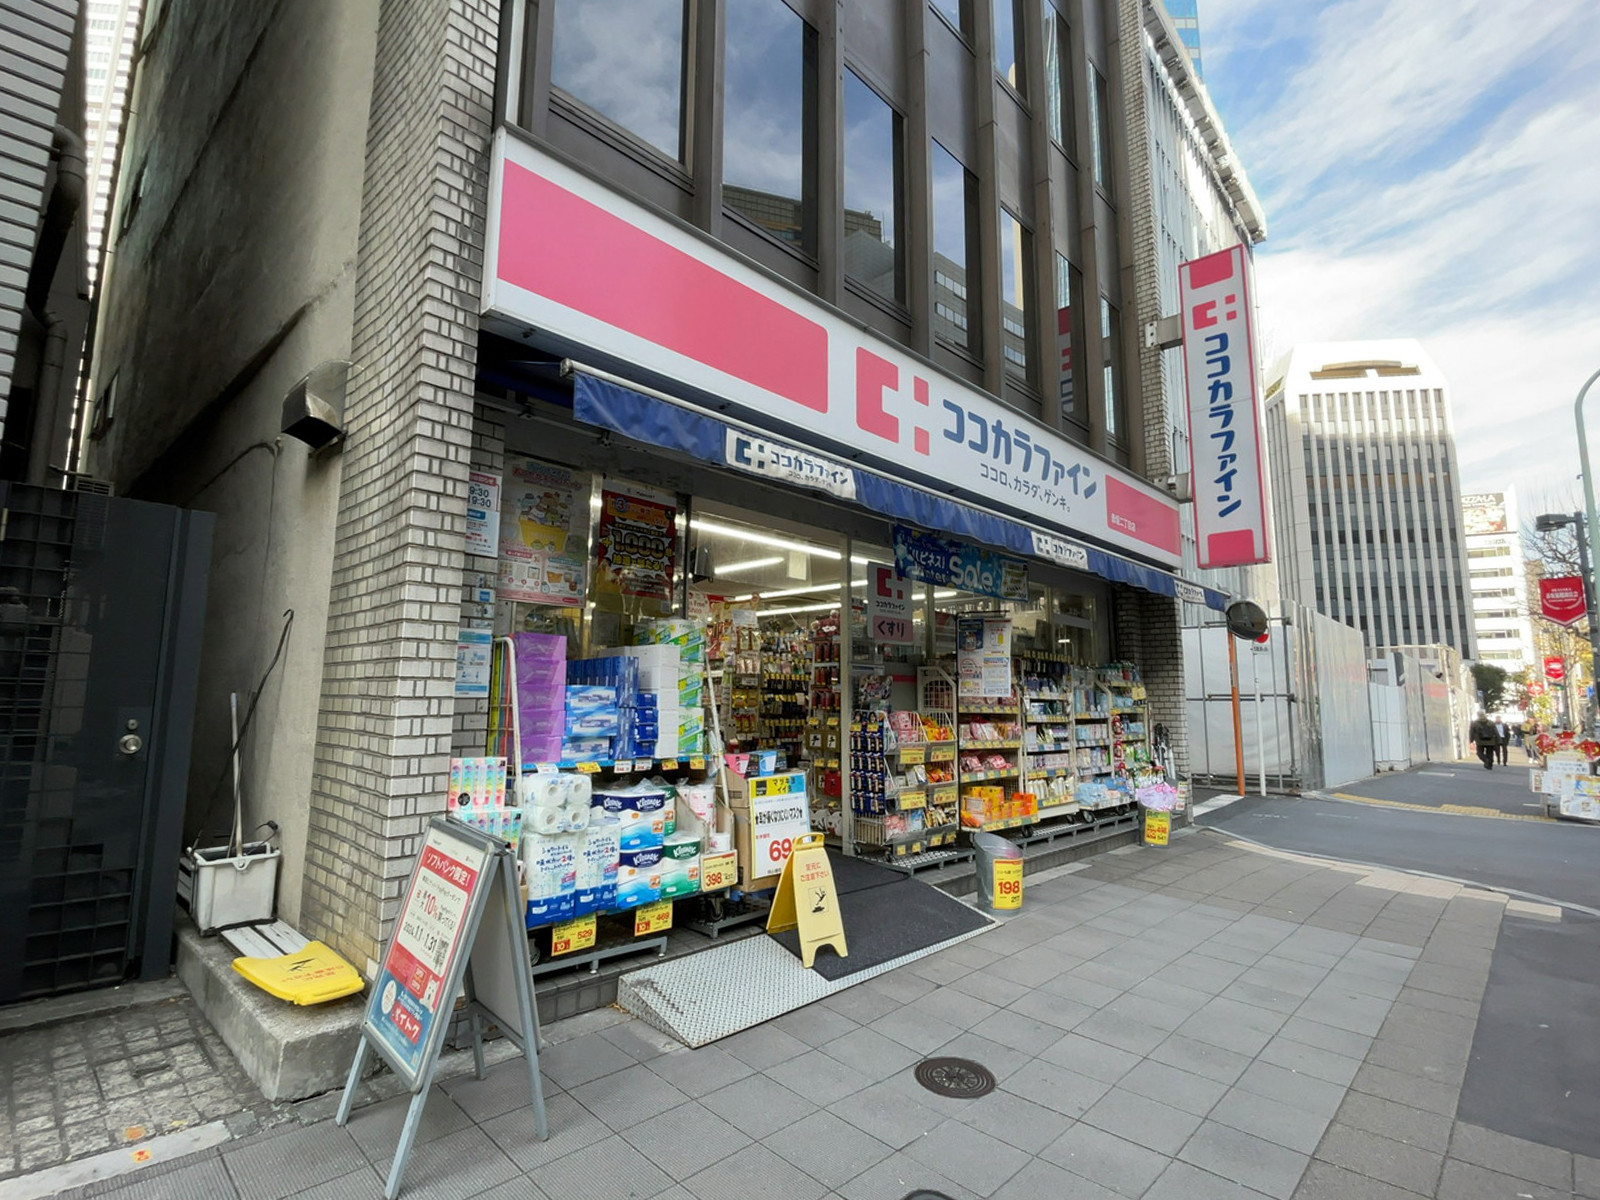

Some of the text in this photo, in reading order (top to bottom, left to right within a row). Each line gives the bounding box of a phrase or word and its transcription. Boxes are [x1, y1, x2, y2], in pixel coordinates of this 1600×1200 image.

[1204, 332, 1242, 518] ココカラファイン
[943, 398, 1098, 499] ココカラファイン
[770, 450, 848, 485] ココカラファイン
[980, 463, 1071, 513] ココロ、カラダ、ゲンキ。
[949, 555, 995, 592] Sale
[877, 620, 905, 638] くすり
[636, 797, 662, 810] Kleenex
[633, 852, 660, 866] Kleenex
[673, 845, 697, 858] Kleenex
[705, 872, 722, 887] 398
[997, 880, 1021, 895] 198
[577, 928, 593, 940] 529
